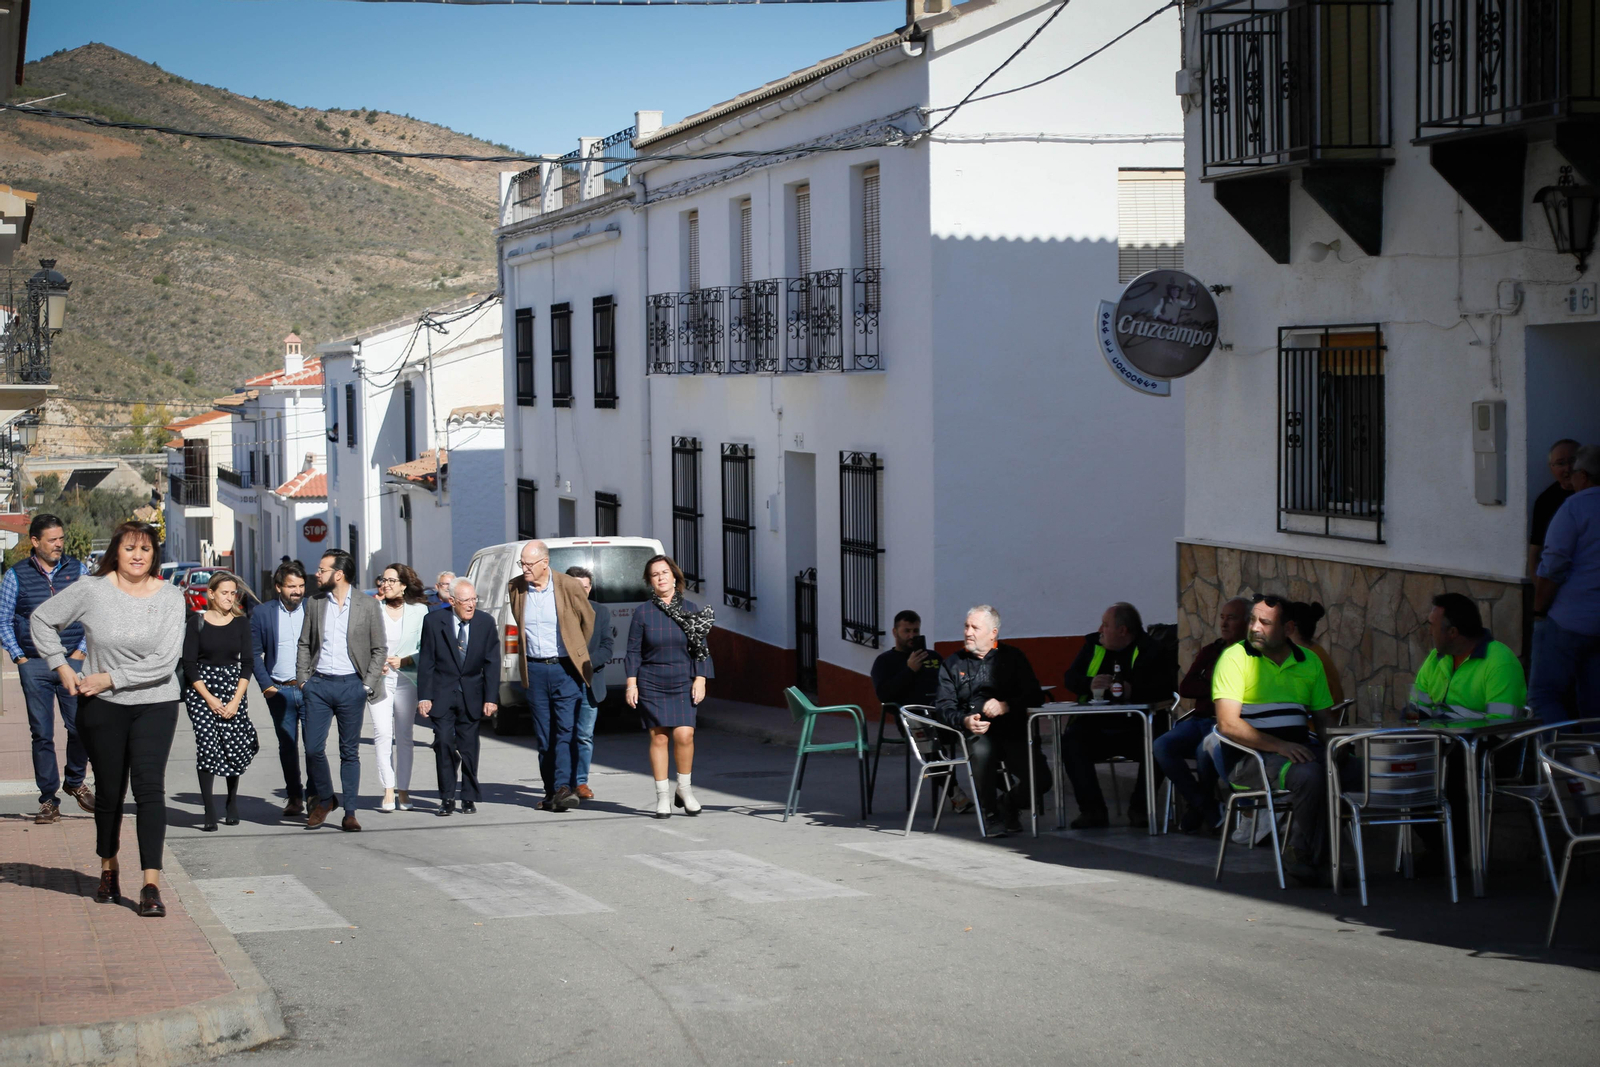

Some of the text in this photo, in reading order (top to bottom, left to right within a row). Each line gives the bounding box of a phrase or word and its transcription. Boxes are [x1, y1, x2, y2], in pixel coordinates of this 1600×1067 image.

[1102, 312, 1111, 335] BAR
[1118, 314, 1213, 348] Cruzcampo
[1104, 338, 1114, 354] EL
[305, 525, 327, 535] STOP
